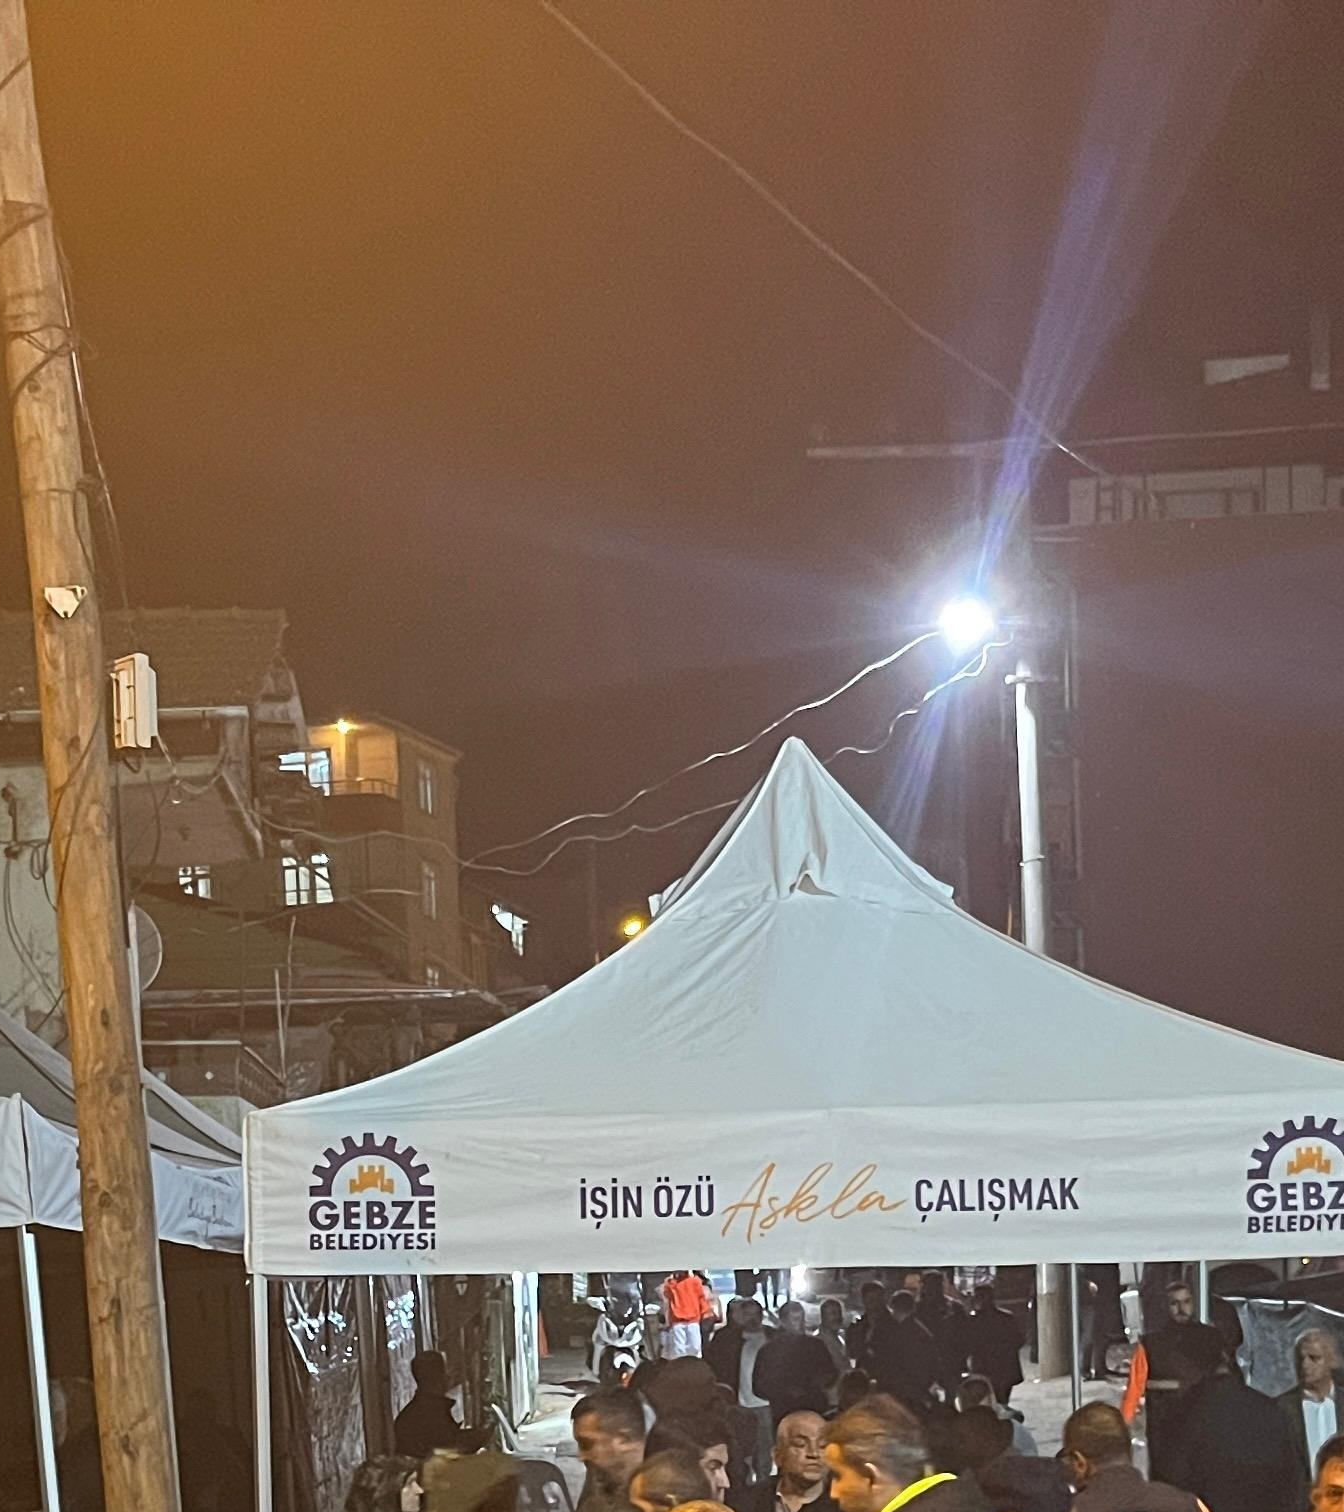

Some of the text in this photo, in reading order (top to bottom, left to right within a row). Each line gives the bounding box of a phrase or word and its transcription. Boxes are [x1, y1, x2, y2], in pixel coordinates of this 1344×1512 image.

[308, 1199, 437, 1232] GEBZE
[579, 1177, 644, 1229] İŞİN
[654, 1175, 715, 1218] ÖZÜ
[915, 1177, 1080, 1222] ÇALIŞMAK
[309, 1232, 437, 1251] BELEDİYESİ
